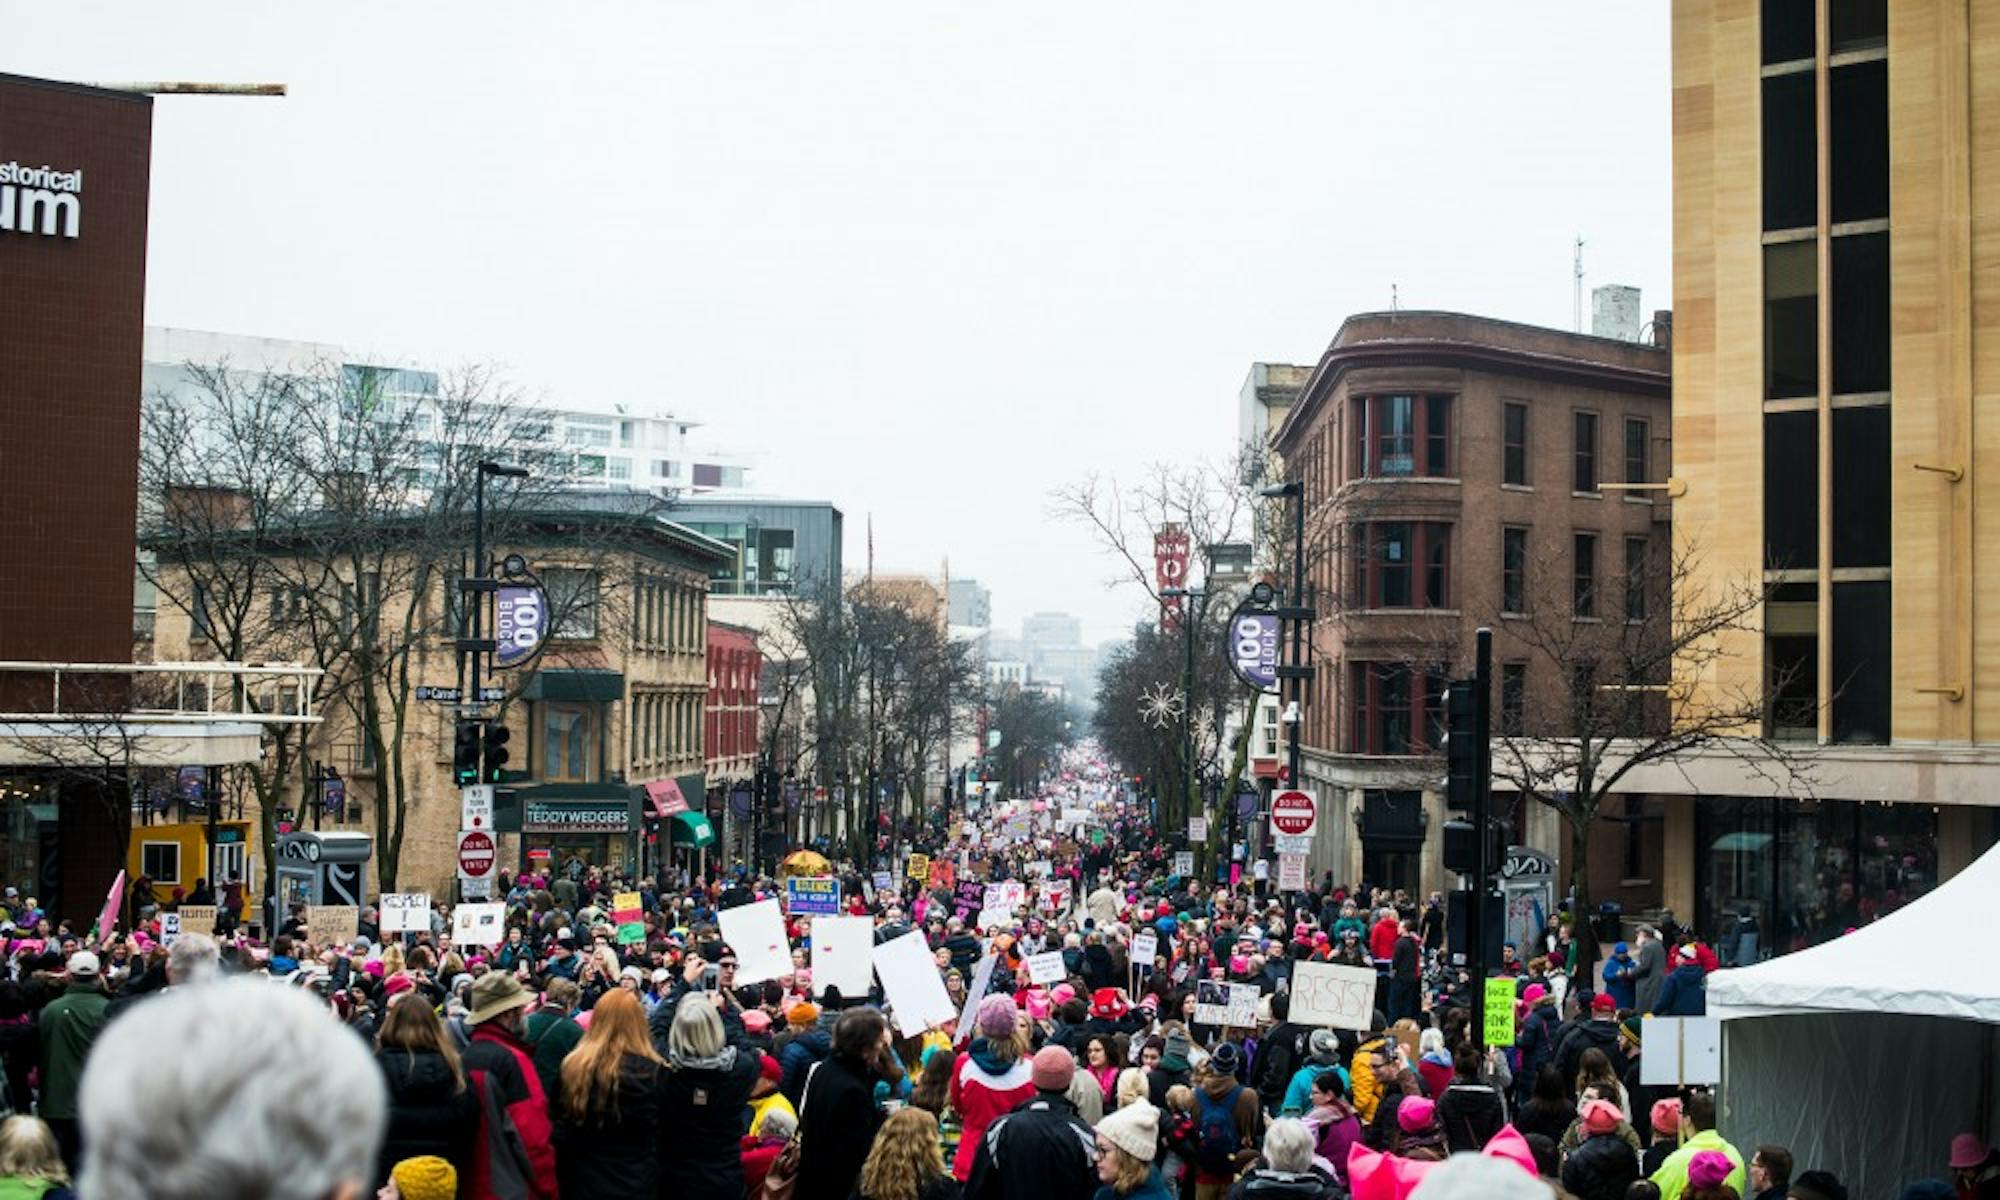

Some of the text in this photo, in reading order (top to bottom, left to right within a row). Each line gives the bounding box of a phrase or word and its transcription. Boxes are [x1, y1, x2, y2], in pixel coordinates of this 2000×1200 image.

[0, 160, 82, 193] storical
[499, 601, 513, 649] BLOCK
[513, 591, 540, 648] 100
[1237, 618, 1262, 671] 100
[1261, 628, 1276, 675] BLOCK
[1279, 799, 1309, 807] DO NOT
[1279, 818, 1307, 828] ENTER
[463, 840, 490, 849] DO NOT
[464, 859, 490, 870] ENTER
[1296, 974, 1374, 1019] RESIST
